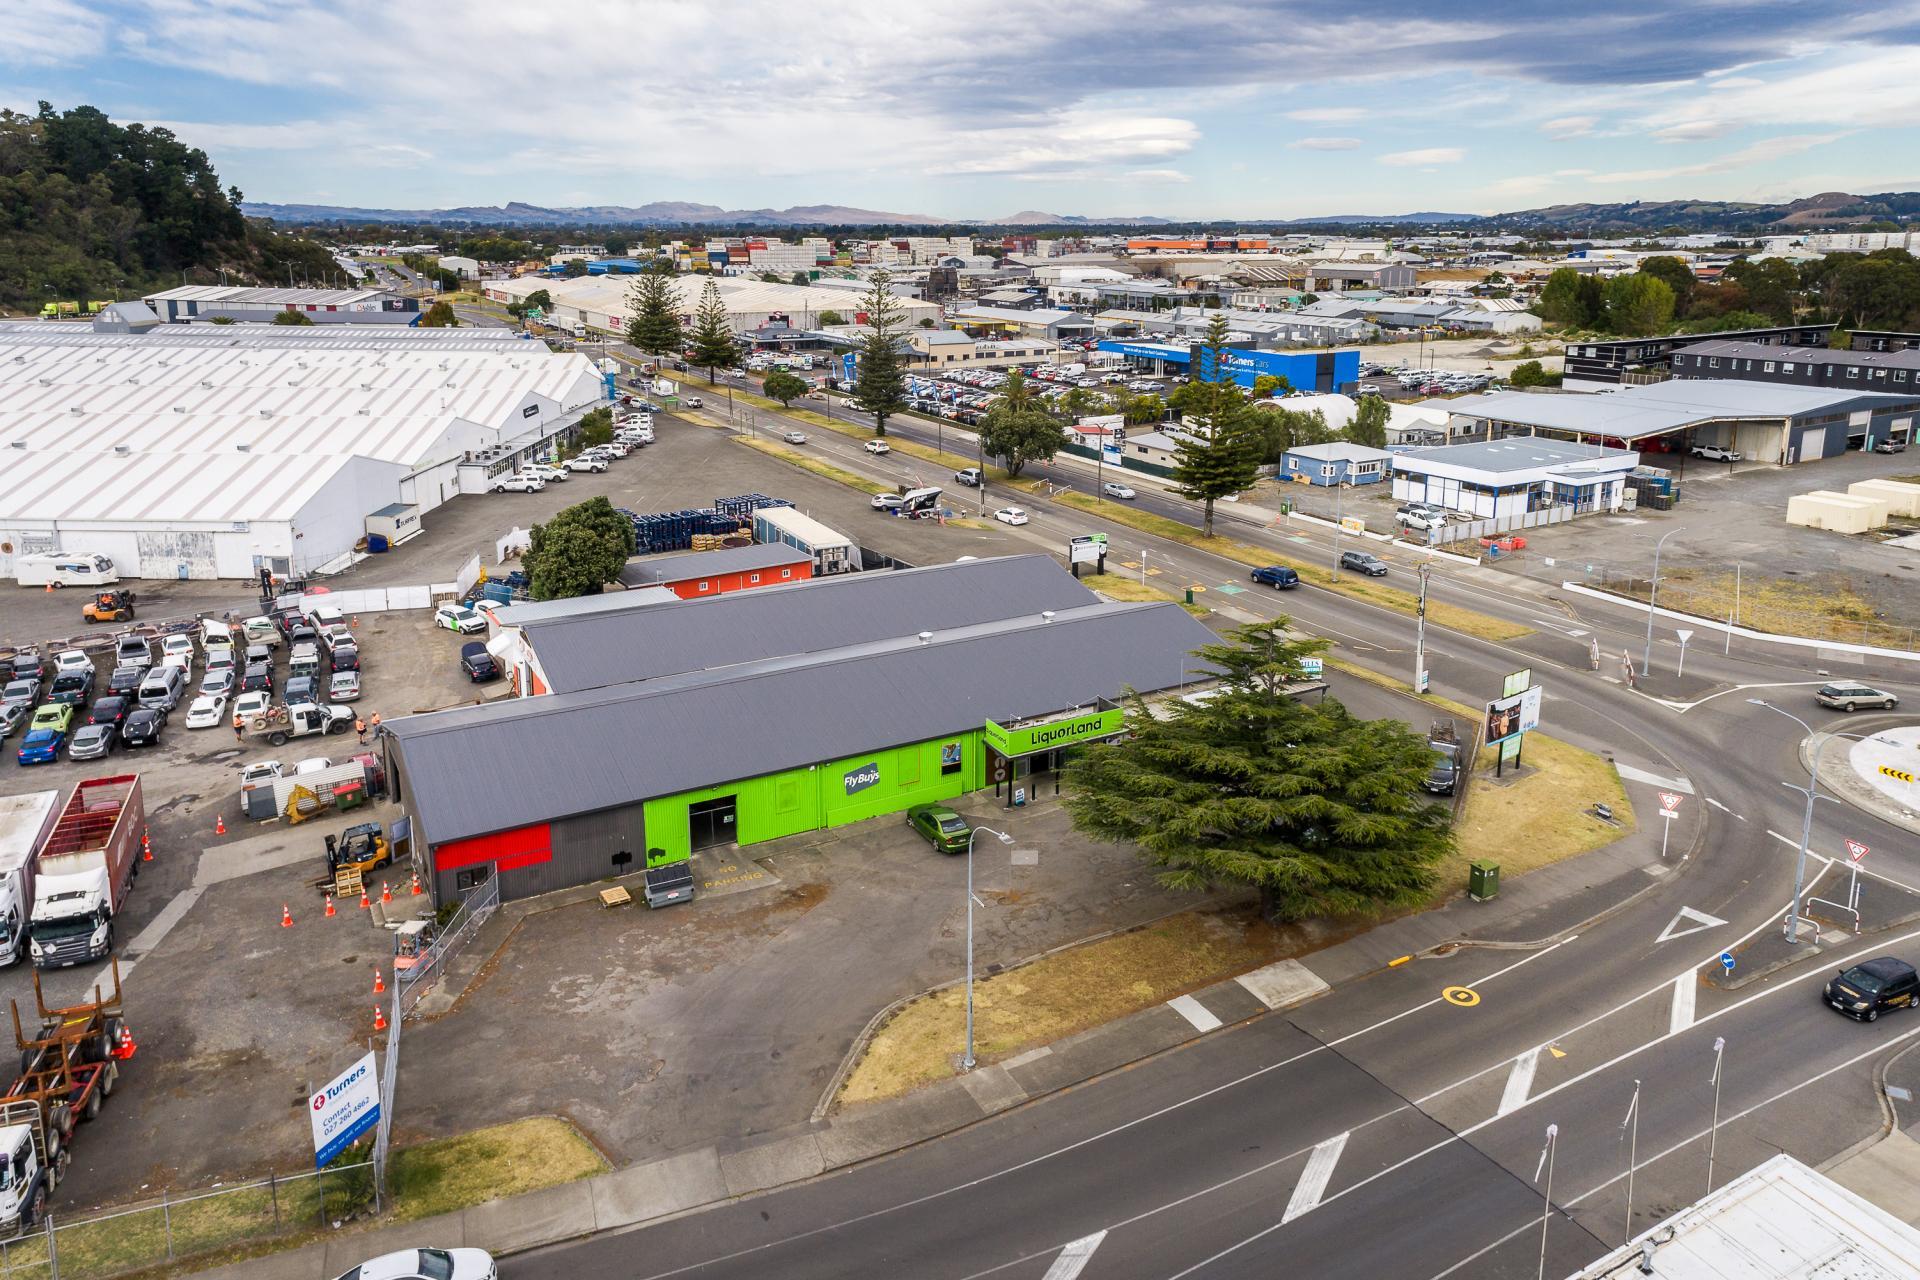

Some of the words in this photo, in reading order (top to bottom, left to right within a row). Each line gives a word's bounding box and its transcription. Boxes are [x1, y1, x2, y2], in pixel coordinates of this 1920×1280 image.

[1031, 718, 1102, 745] LiquorLand
[326, 1065, 366, 1100] Turners
[323, 1101, 351, 1127] Contact
[324, 1123, 338, 1136] 027
[339, 1112, 352, 1126] 260
[353, 1096, 370, 1112] 4862
